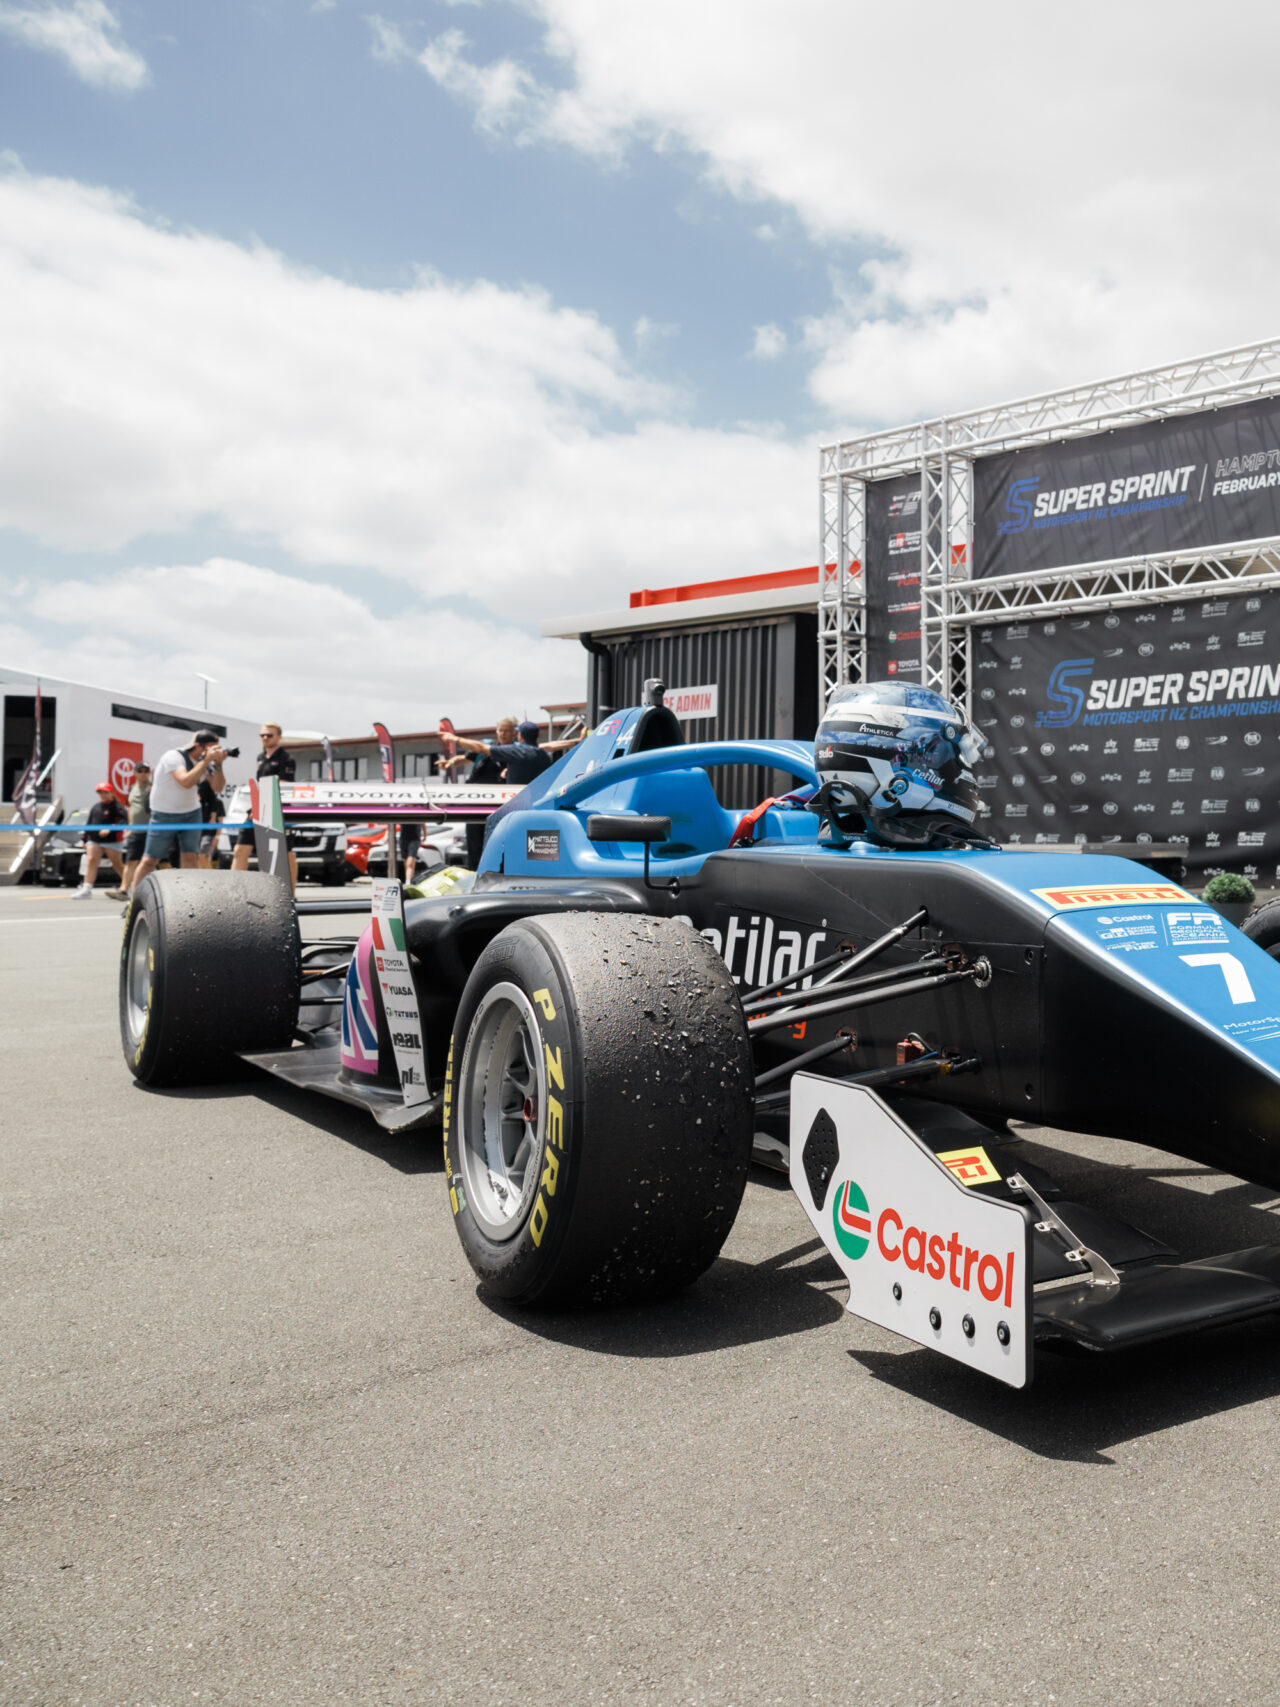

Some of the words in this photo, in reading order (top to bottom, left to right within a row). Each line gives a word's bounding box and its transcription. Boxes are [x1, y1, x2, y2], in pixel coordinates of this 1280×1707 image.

[1034, 482, 1106, 517] SUPER
[1108, 465, 1196, 504] SPRINT
[1032, 510, 1093, 530] MOTORSPORT
[1095, 509, 1109, 520] NZ
[1110, 495, 1186, 517] CHAMPIONSHIP
[1086, 673, 1184, 710] SUPER
[676, 693, 712, 712] ADMIN
[1083, 709, 1167, 727] MOTORSPORT
[1169, 706, 1187, 721] NZ
[595, 719, 621, 736] GR
[912, 768, 945, 785] Cetilar
[321, 791, 409, 799] TOYOTA
[1046, 887, 1185, 905] PIRELLI
[1112, 914, 1154, 923] Castrol
[1166, 912, 1222, 926] FR
[672, 914, 826, 991] etilar
[384, 959, 404, 967] TOYOTA
[1178, 952, 1257, 1004] 7
[389, 985, 413, 996] YUASA
[533, 988, 556, 1022] P
[530, 1046, 565, 1249] ZERO
[877, 1208, 1015, 1308] Castrol
